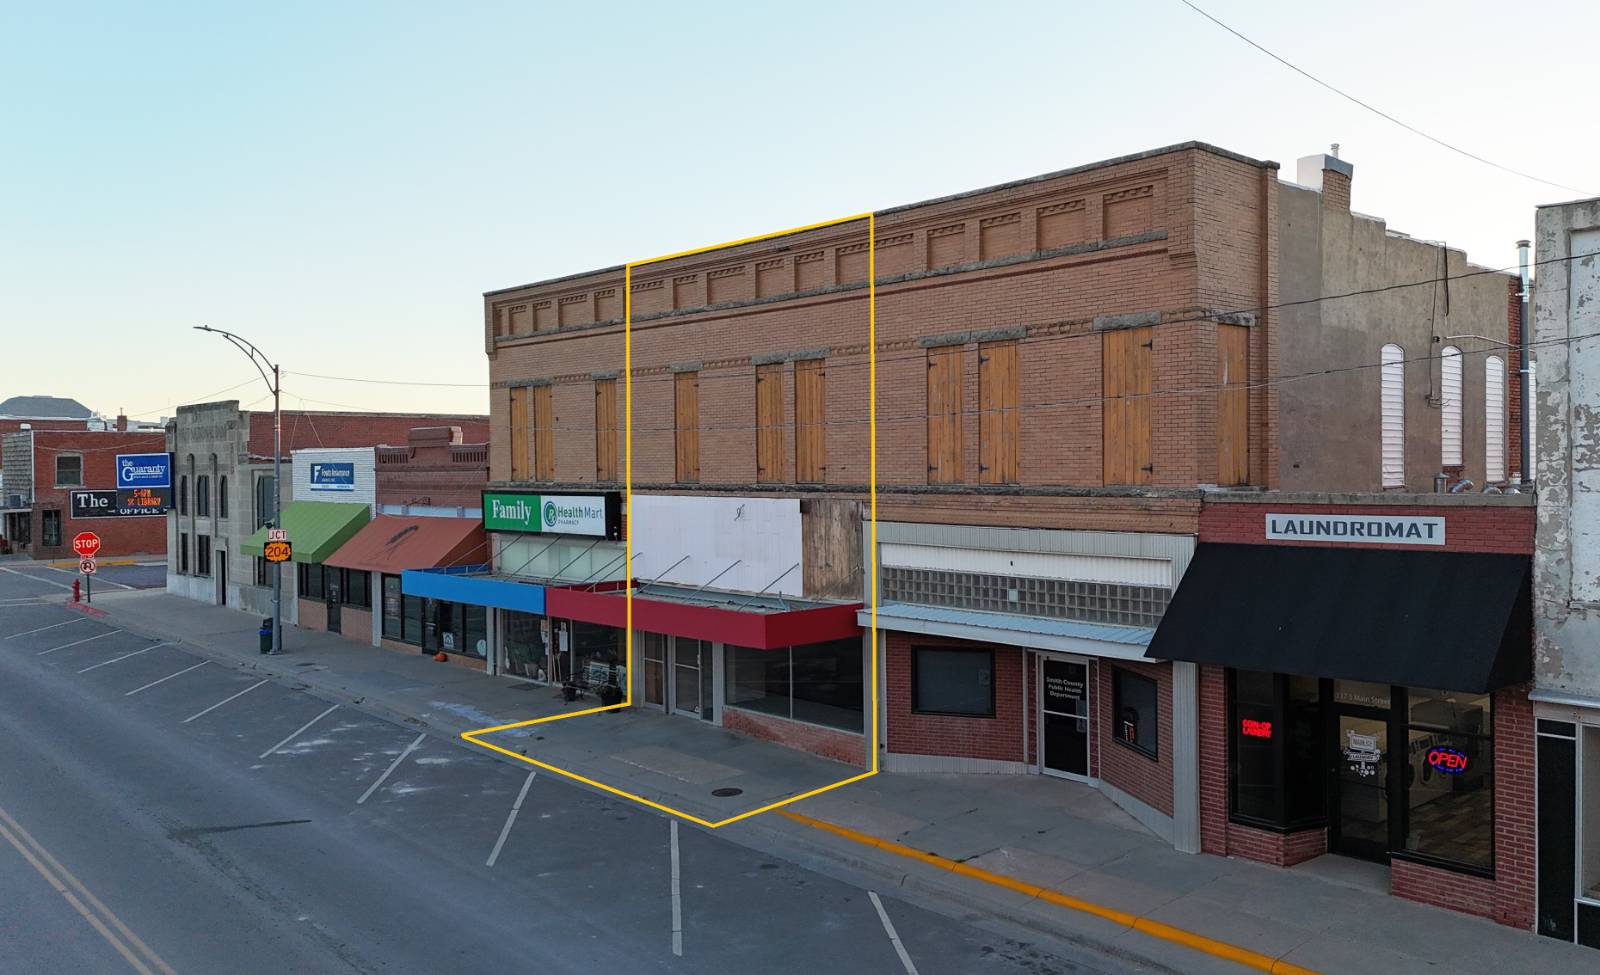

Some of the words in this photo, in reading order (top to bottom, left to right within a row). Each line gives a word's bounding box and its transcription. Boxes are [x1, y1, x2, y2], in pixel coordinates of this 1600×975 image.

[122, 464, 166, 481] Guaranty
[77, 493, 108, 508] The
[137, 497, 160, 506] LIBRARY
[492, 500, 531, 525] Family
[558, 506, 583, 519] Health
[584, 507, 603, 519] Mart
[1271, 519, 1438, 539] LAUNDROMAT
[269, 530, 286, 540] JCT
[75, 539, 98, 549] STOP
[267, 546, 289, 557] 204
[1046, 676, 1062, 684] Smith
[1063, 679, 1083, 688] County
[1048, 683, 1063, 691] Public
[1065, 686, 1082, 694] Health
[1050, 690, 1080, 700] Department
[1371, 696, 1390, 704] Street
[1428, 752, 1467, 769] OPEN
